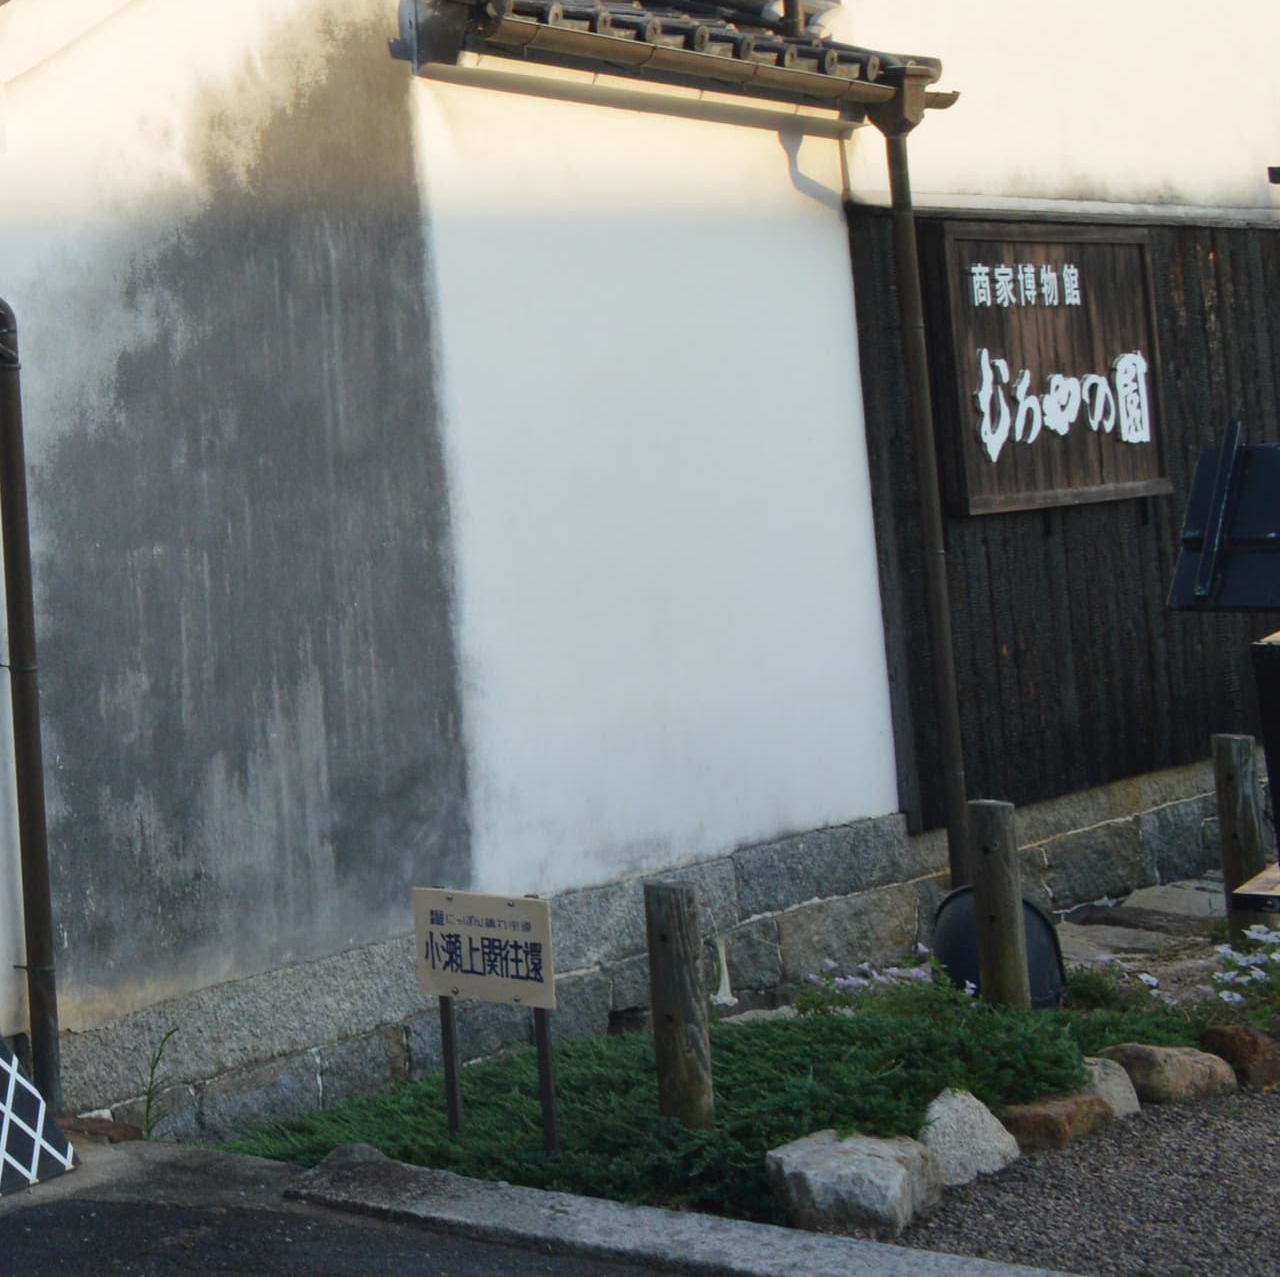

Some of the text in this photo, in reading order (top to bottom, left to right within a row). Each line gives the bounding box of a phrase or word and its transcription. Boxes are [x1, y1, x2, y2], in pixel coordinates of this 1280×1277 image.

[971, 263, 1081, 307] 商家博物館
[425, 931, 544, 984] 小瀬上関往還
